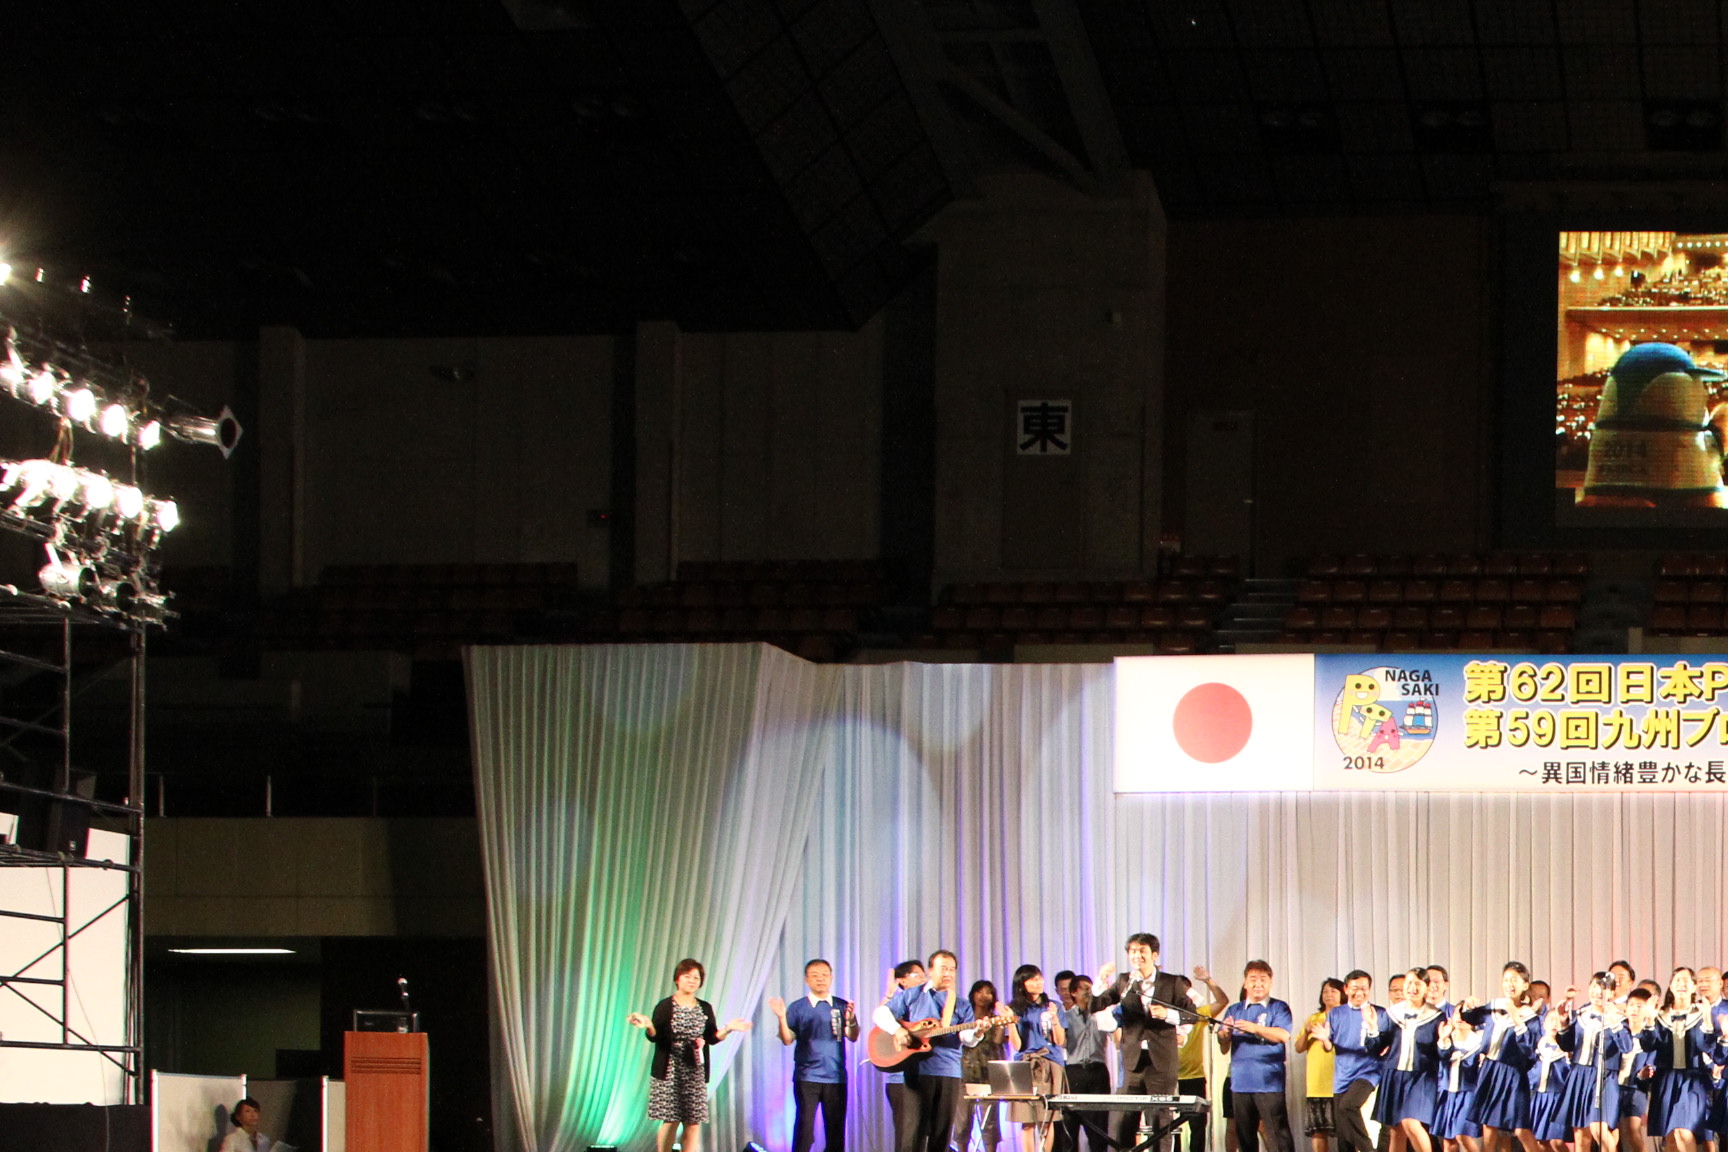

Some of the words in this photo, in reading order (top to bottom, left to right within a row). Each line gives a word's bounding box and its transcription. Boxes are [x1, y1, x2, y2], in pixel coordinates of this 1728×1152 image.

[1019, 402, 1068, 452] 東
[1385, 669, 1432, 682] NAGA
[1401, 683, 1439, 696] SAKI
[1343, 756, 1384, 770] 2014
